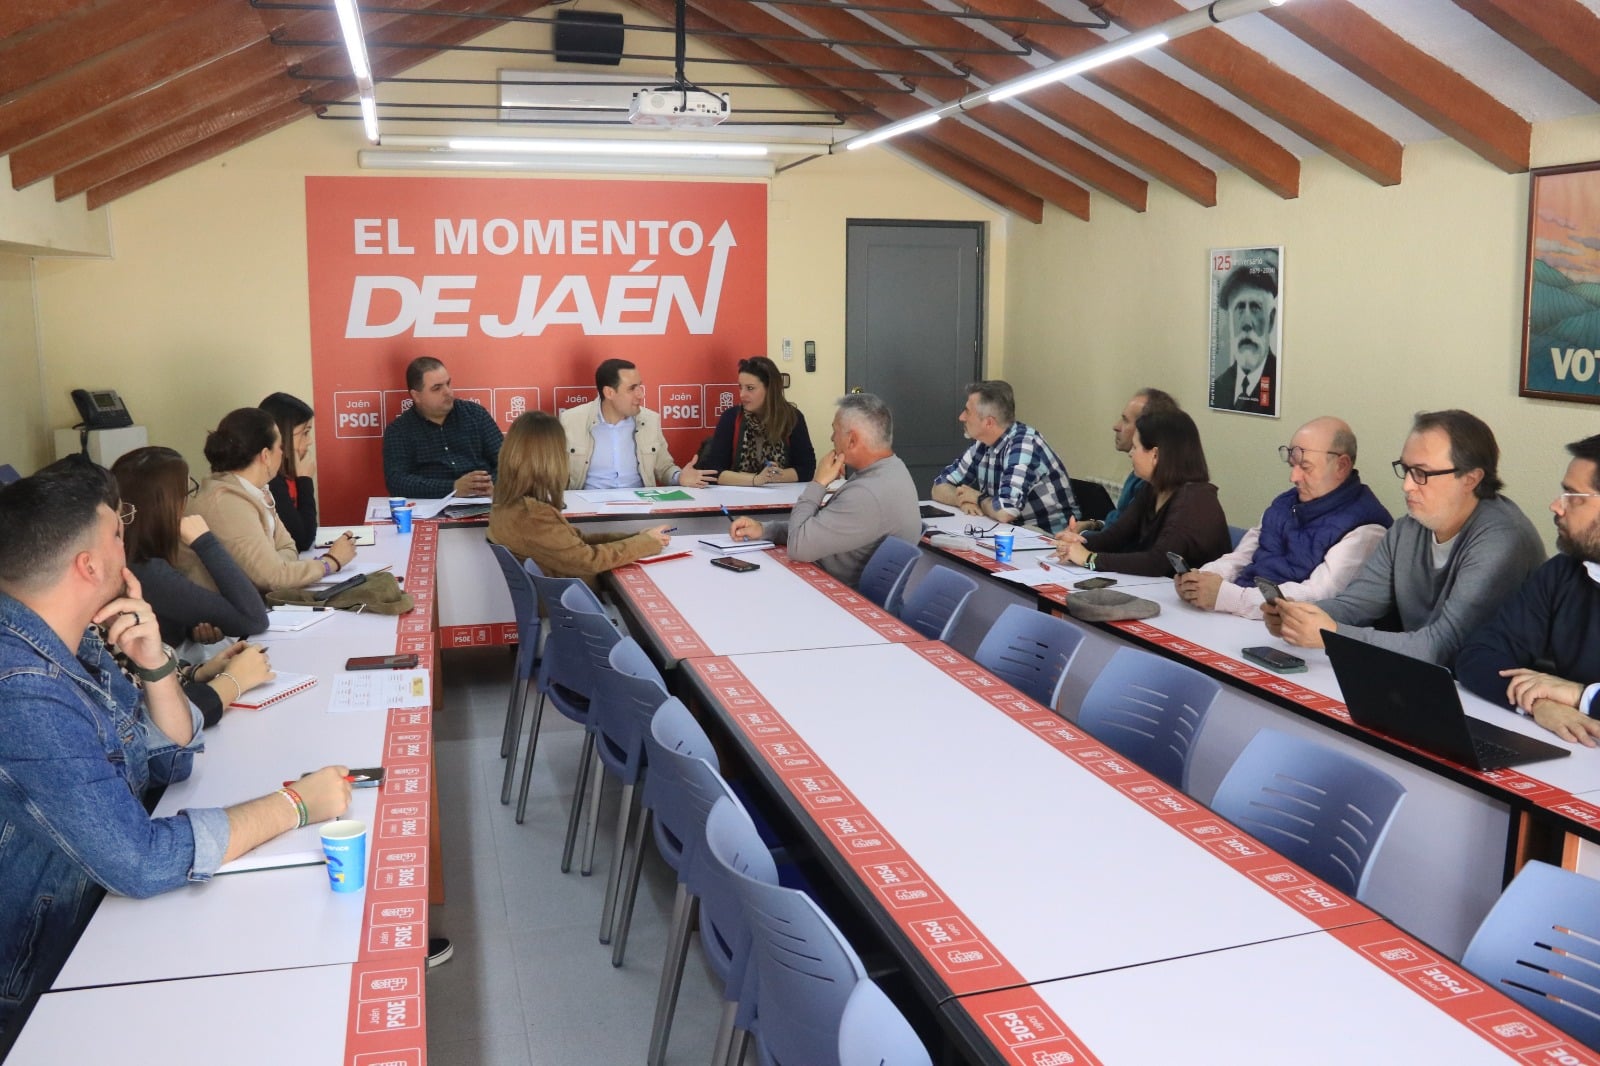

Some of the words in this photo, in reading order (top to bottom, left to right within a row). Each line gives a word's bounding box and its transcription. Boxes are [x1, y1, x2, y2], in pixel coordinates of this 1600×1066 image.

[353, 218, 415, 255] EL
[434, 218, 703, 257] MOMENTO
[1213, 255, 1231, 270] 125
[344, 274, 478, 339] DE
[479, 259, 722, 338] JAÉN
[346, 399, 370, 409] Jaén
[565, 394, 588, 404] Jaén
[670, 392, 692, 401] Jaén
[339, 412, 380, 428] PSOE
[663, 404, 700, 420] PSOE
[1557, 805, 1598, 821] PSOE
[402, 819, 417, 836] PSOE
[833, 817, 858, 834] PSOE
[1224, 838, 1257, 857] PSOE
[398, 866, 415, 887] PSOE
[873, 864, 901, 884] PSOE
[1300, 887, 1339, 908] PSOE
[394, 925, 413, 948] PSOE
[921, 919, 952, 944] PSOE
[1423, 967, 1470, 995] PSOE
[369, 1007, 381, 1024] Jaén
[386, 999, 406, 1029] PSOE
[1025, 1013, 1046, 1032] Jaén
[997, 1011, 1037, 1042] PSOE
[1546, 1047, 1589, 1066] OE
